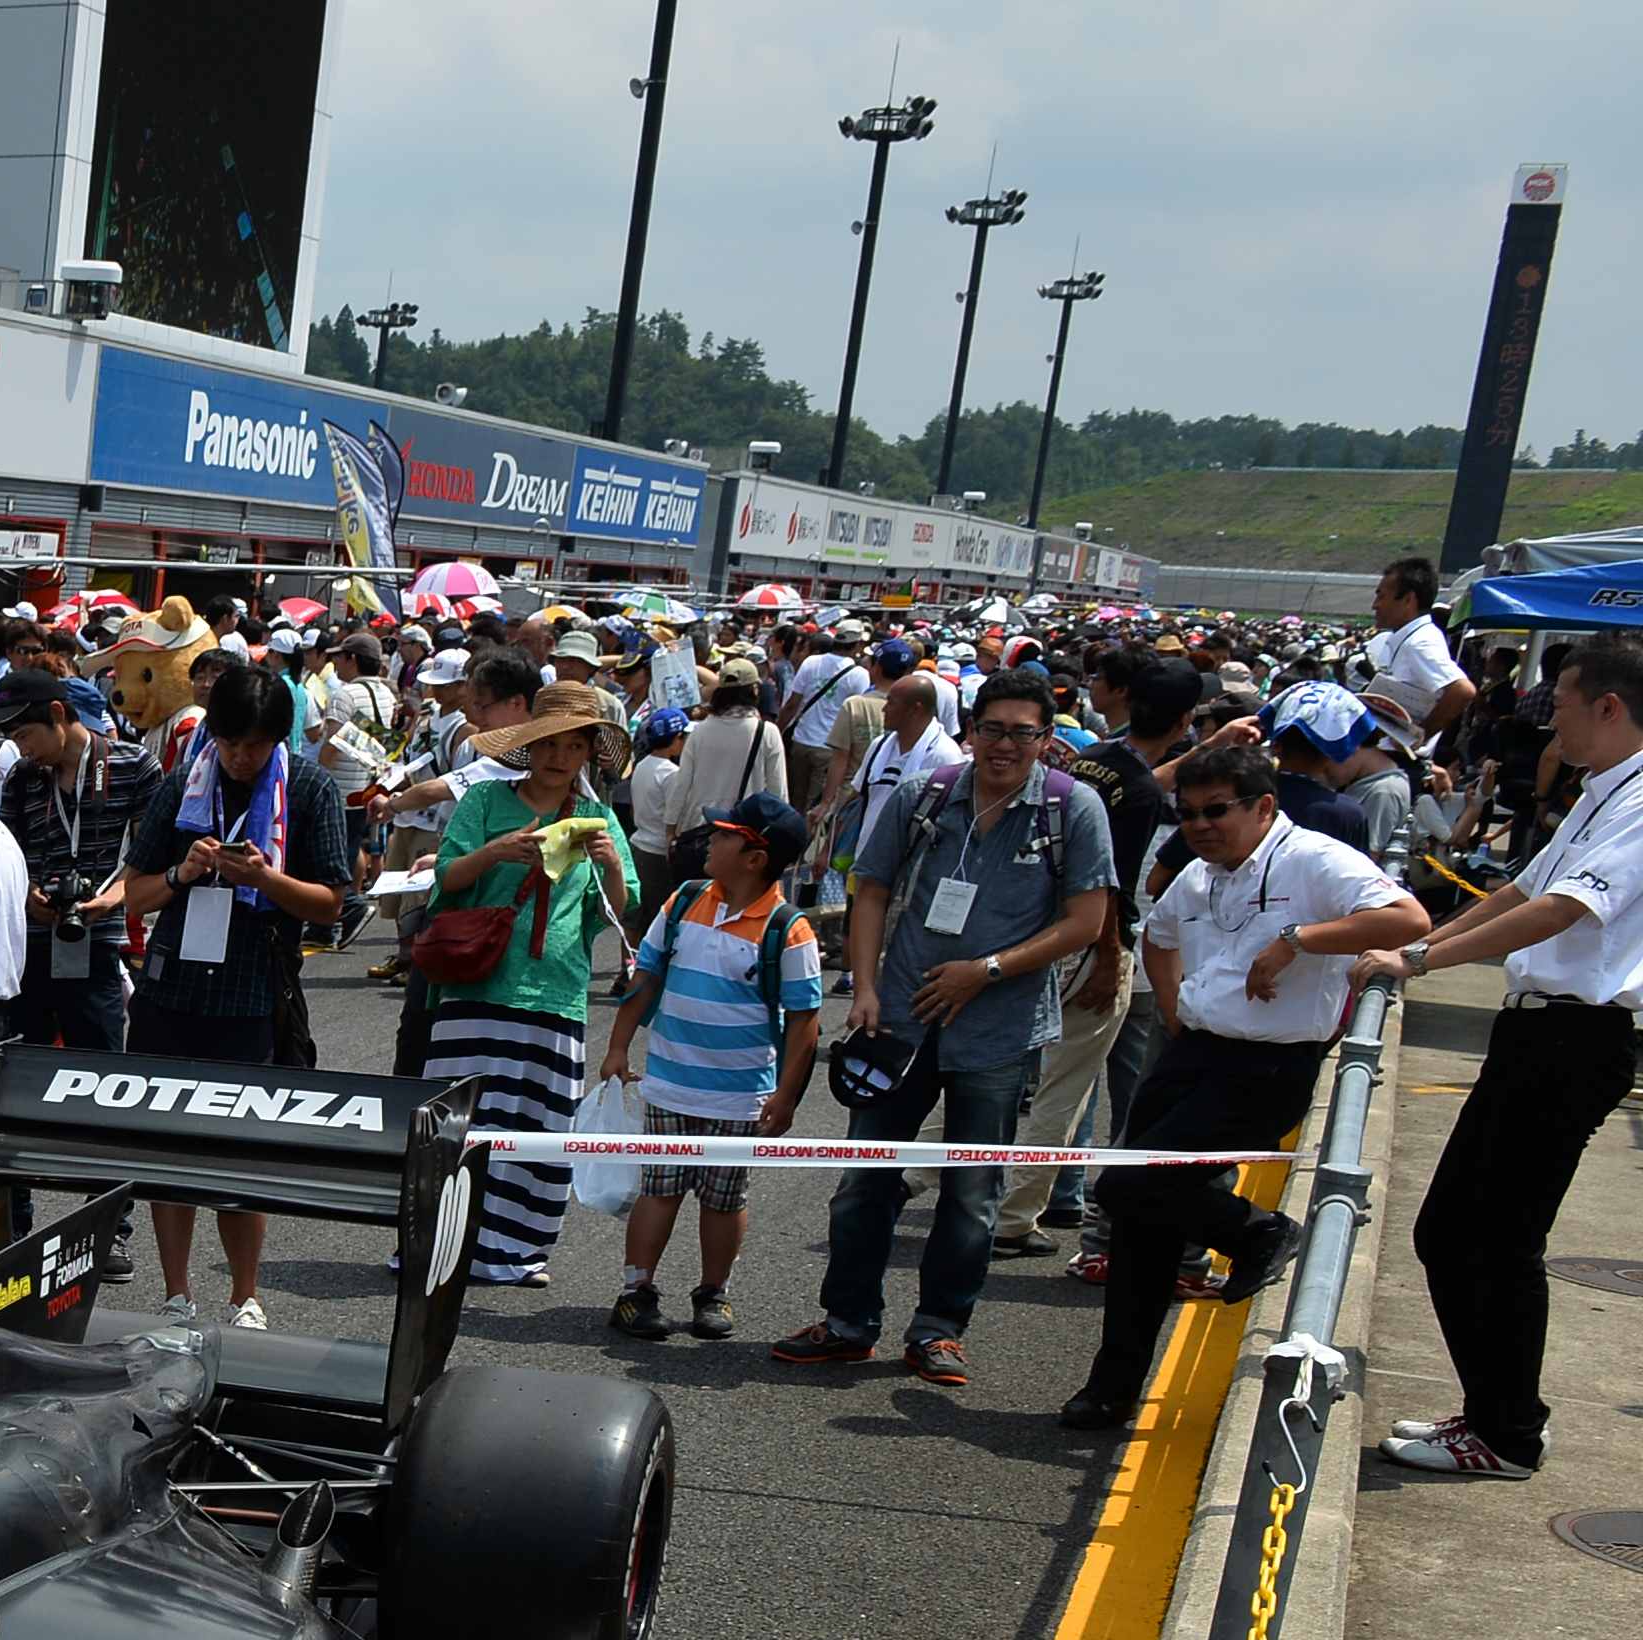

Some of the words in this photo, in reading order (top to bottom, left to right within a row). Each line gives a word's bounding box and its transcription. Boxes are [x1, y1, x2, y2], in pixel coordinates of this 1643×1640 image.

[184, 390, 317, 480] Panasonic
[406, 460, 475, 504] HONDA
[576, 480, 641, 528] KEIHIN
[642, 492, 697, 534] KEIHIN
[43, 1069, 384, 1133] POTENZA
[57, 1233, 95, 1264] SUPER
[425, 1166, 471, 1297] 00
[55, 1250, 94, 1290] FORMULA
[47, 1284, 82, 1320] TOYOTA
